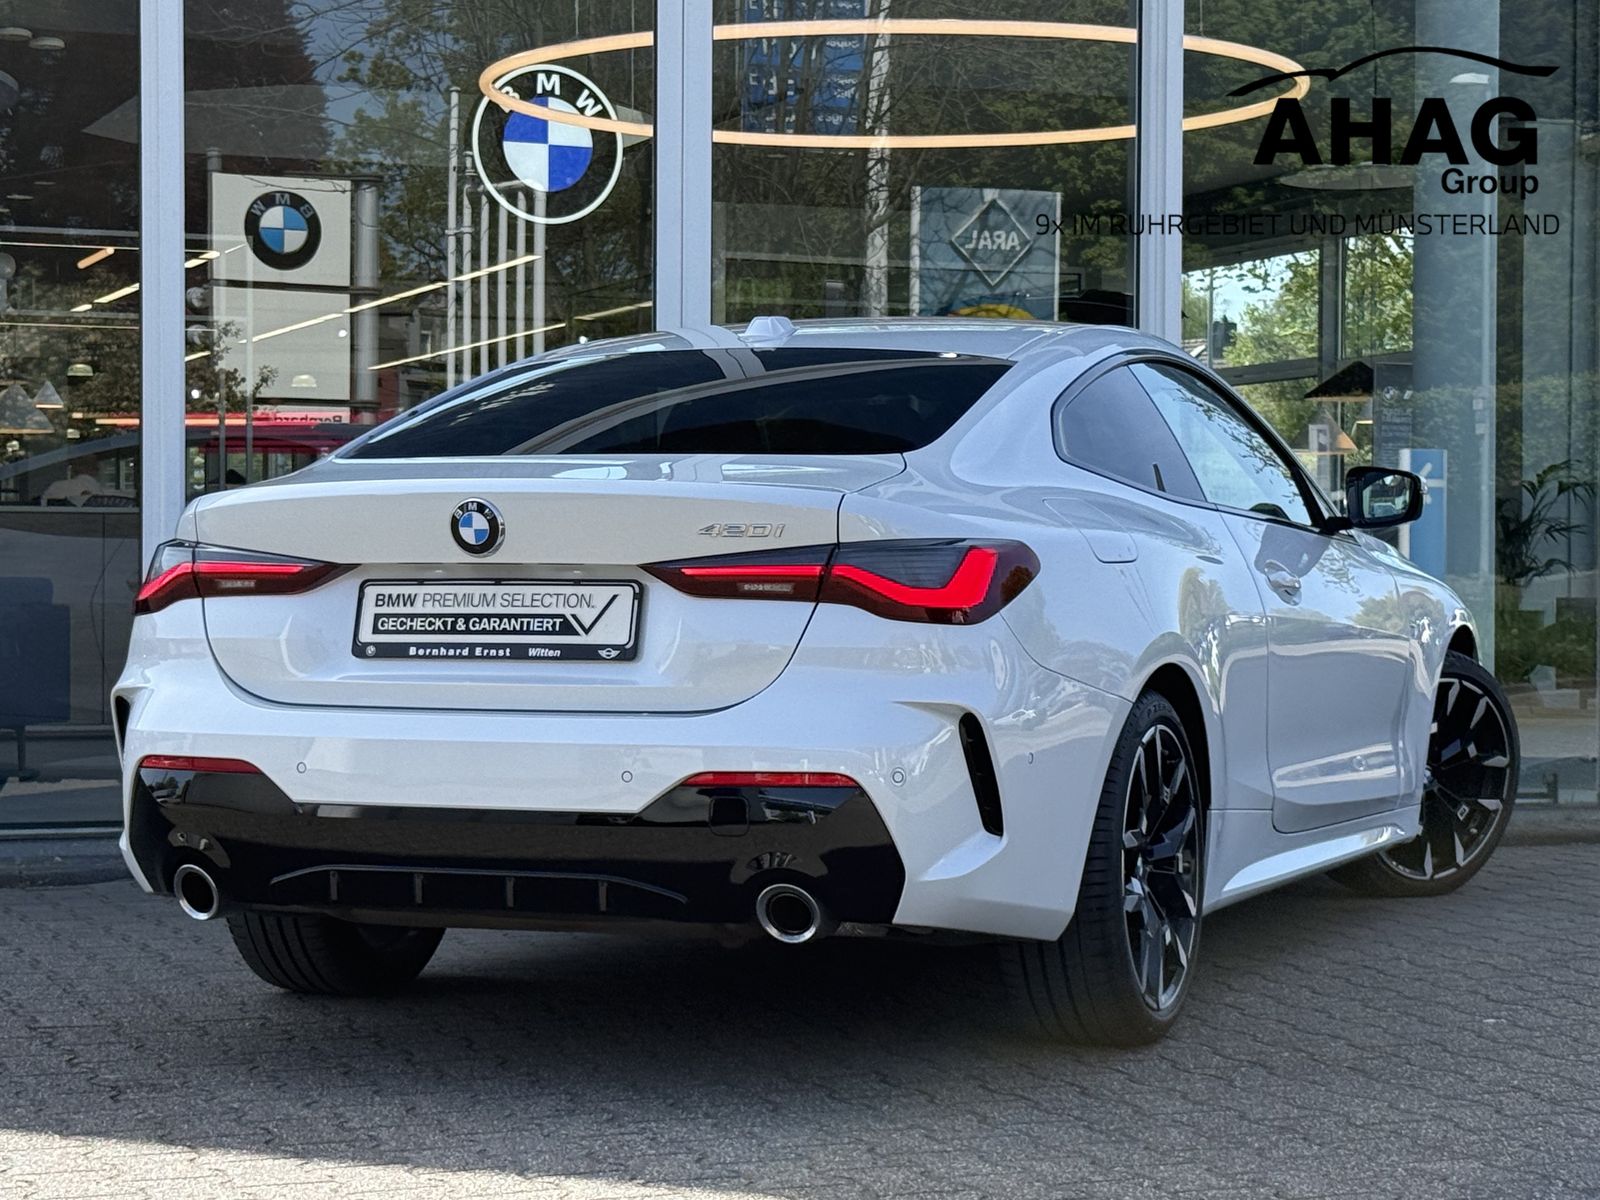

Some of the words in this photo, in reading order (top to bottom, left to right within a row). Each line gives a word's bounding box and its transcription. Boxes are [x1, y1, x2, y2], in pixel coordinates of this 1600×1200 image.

[454, 502, 495, 520] BMW
[697, 523, 786, 538] 420i
[375, 592, 418, 608] BMW
[421, 592, 497, 608] PREMIUM
[377, 617, 455, 631] GECHECKT
[455, 617, 467, 631] &
[468, 617, 564, 632] GARANTIERT
[408, 646, 469, 657] Bernhard
[474, 646, 511, 657] Ernst
[528, 647, 562, 658] Witten
